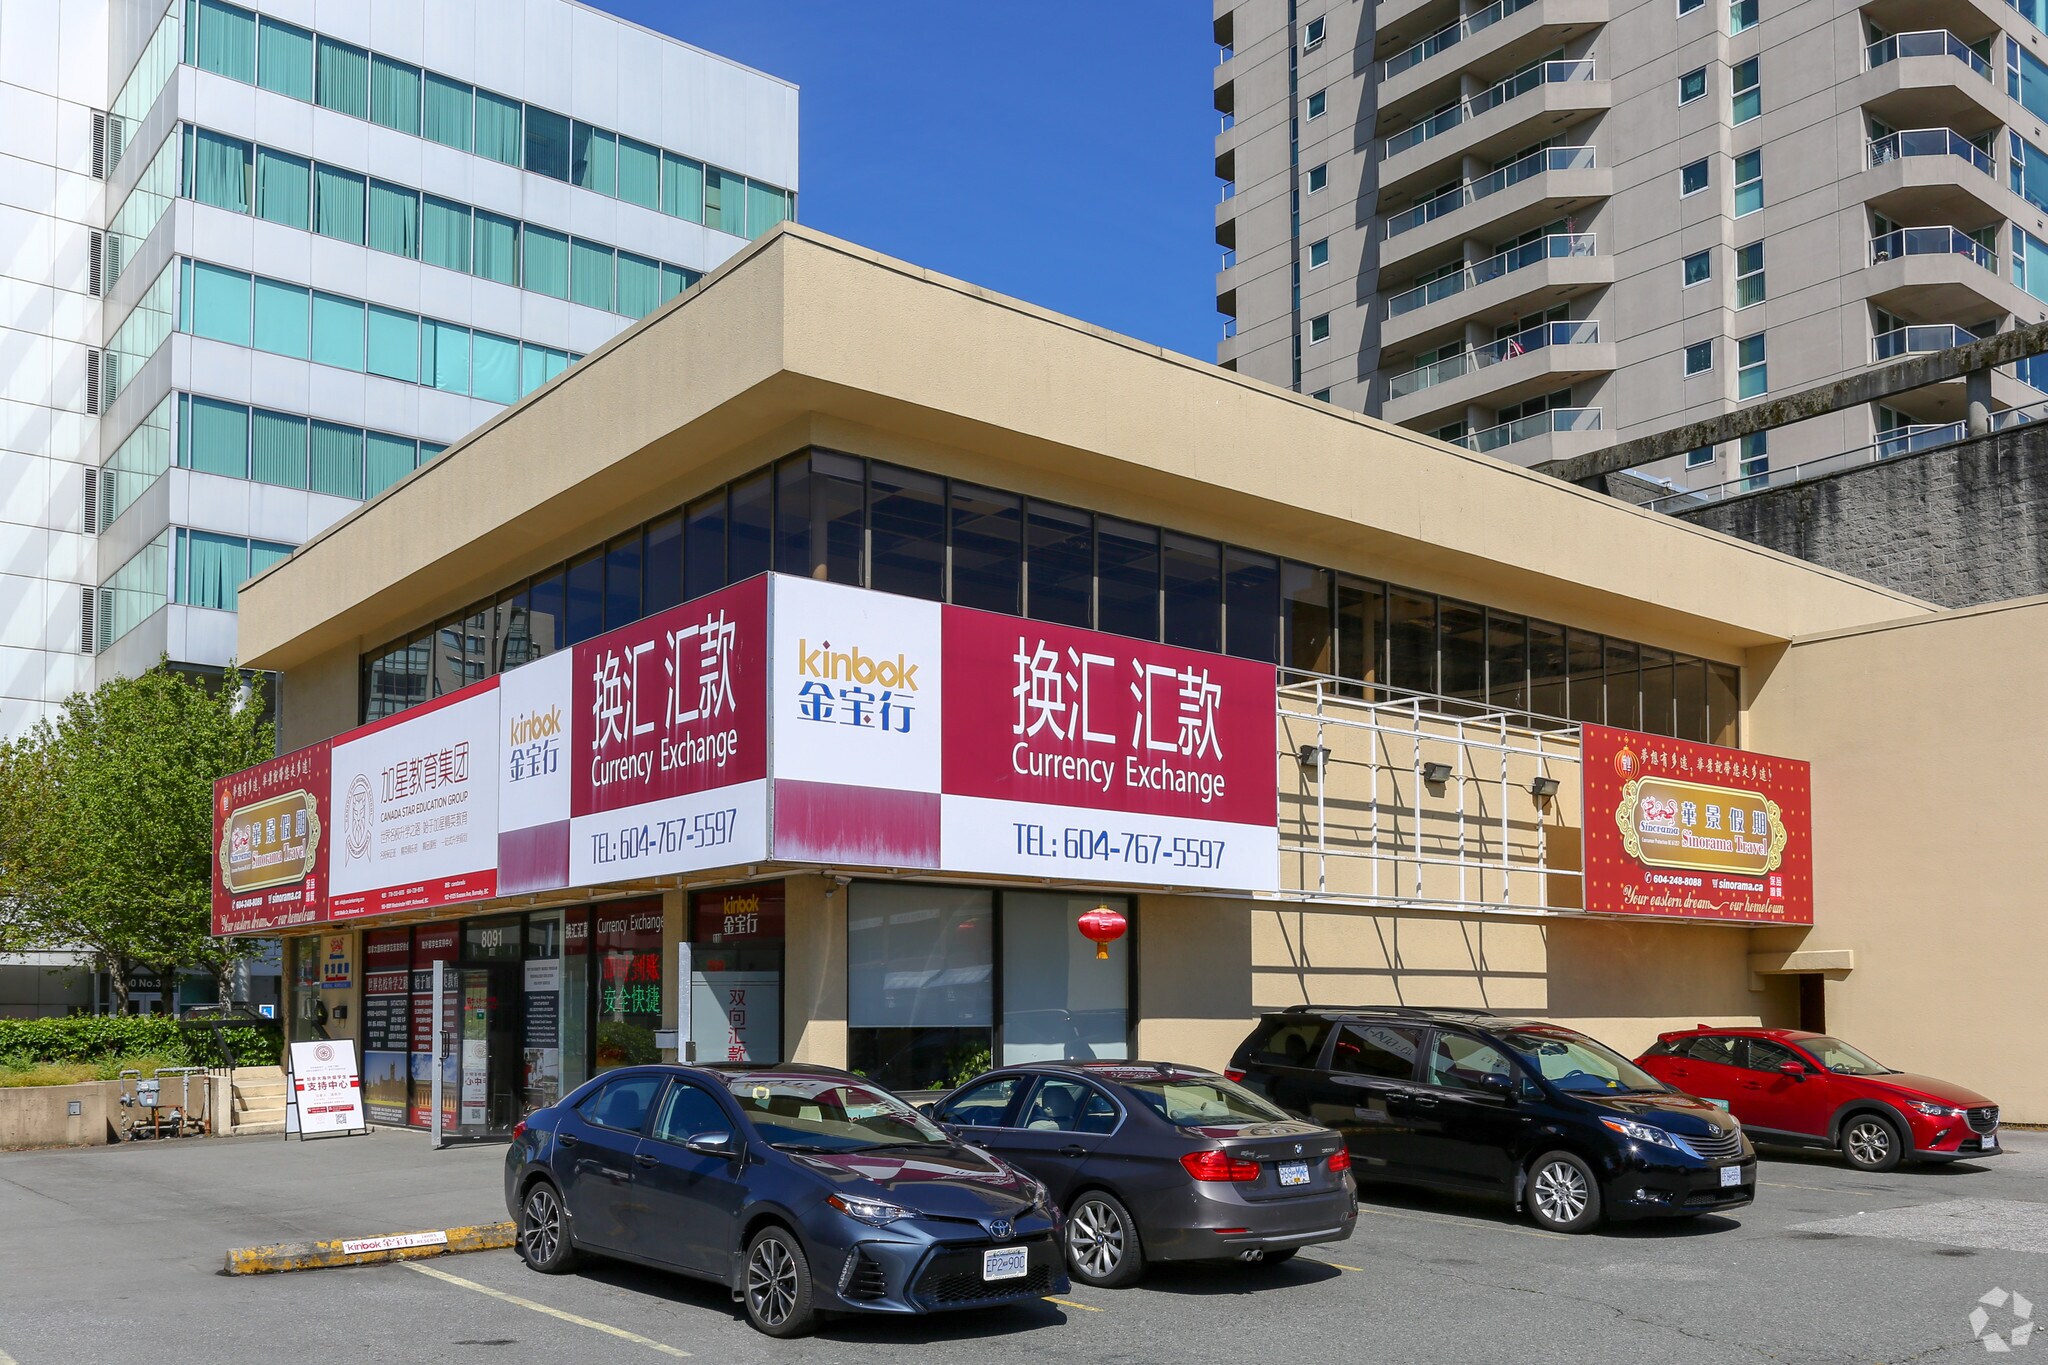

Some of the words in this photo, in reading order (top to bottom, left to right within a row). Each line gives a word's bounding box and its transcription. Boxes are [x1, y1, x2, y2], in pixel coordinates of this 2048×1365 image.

[592, 640, 655, 750] 换汇
[664, 609, 736, 730] 汇款
[799, 639, 919, 691] kinbok
[797, 681, 916, 733] 金宝行
[1013, 636, 1116, 744] 换汇
[1130, 657, 1223, 762] 汇款
[510, 704, 561, 747] kinbok
[381, 741, 469, 804] 加星教育集团
[509, 738, 559, 783] 金宝行
[591, 750, 653, 787] Currency
[661, 729, 738, 772] Exchange
[1012, 742, 1115, 792] Currency
[1126, 756, 1225, 803] Exchange
[380, 809, 402, 823] CANADA
[402, 806, 416, 817] STAR
[416, 797, 447, 814] EDUCATION
[447, 790, 469, 806] GROUP
[1681, 802, 1767, 835] 華景假期
[591, 832, 617, 864] TEL:
[620, 808, 737, 860] 604-767-5597
[1013, 823, 1057, 857] TEL:
[1064, 828, 1225, 869] 604-767-5597
[1681, 830, 1733, 853] Sinorama
[1734, 834, 1767, 856] Travel
[252, 850, 282, 869] Sinorama
[283, 842, 305, 862] Travel
[1653, 874, 1702, 887] 604-248-8088
[1719, 879, 1763, 892] sinorama.ca
[272, 891, 302, 904] sinorama.ca
[723, 894, 759, 914] kinbok
[1623, 885, 1648, 905] Your
[1650, 890, 1682, 908] eastern
[1683, 892, 1711, 909] dream
[1730, 901, 1743, 911] our
[1744, 897, 1784, 914] hometown
[481, 929, 502, 948] 8091
[597, 918, 628, 936] Currency
[630, 913, 663, 933] Exchange
[723, 913, 758, 935] 金宝行
[604, 984, 660, 1013] 安全快捷
[728, 989, 746, 1061] 双向汇款
[307, 1080, 348, 1091] 支持中心
[347, 1241, 382, 1251] kinbok
[986, 1258, 1003, 1273] EP2
